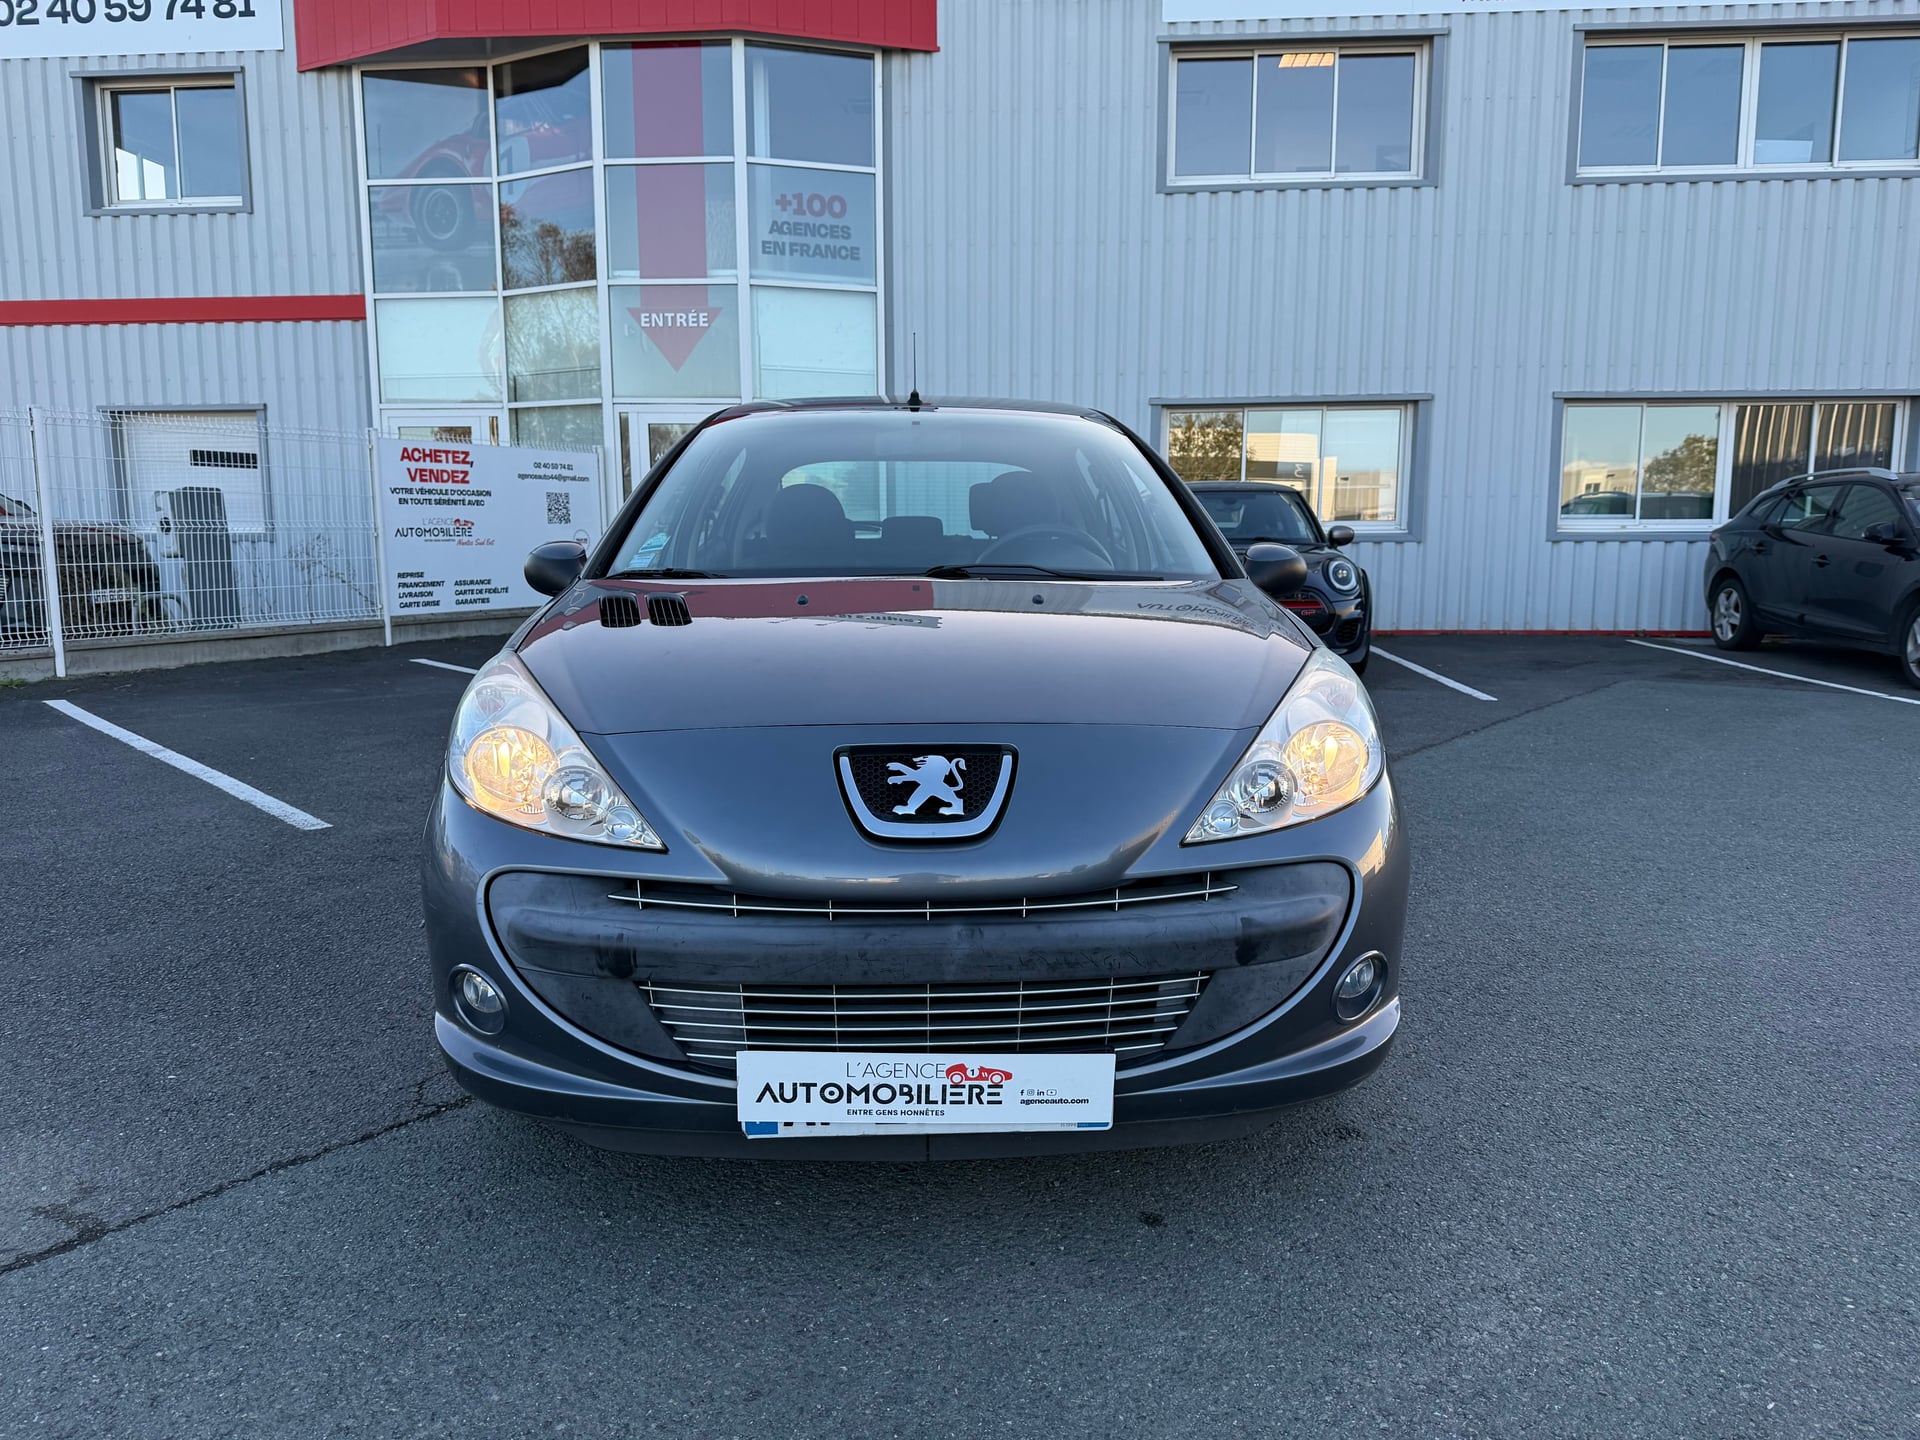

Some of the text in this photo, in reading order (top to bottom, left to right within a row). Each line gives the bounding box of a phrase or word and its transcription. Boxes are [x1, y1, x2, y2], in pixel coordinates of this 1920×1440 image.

[46, 0, 96, 24] 40
[103, 0, 152, 23] 59
[775, 192, 847, 219] +100
[768, 220, 852, 240] AGENCES
[761, 240, 861, 261] EN FRANCE
[640, 310, 709, 327] ENTRÉE
[400, 447, 474, 468] ACHETEZ,
[407, 468, 470, 484] VENDEZ
[390, 486, 492, 497] VOTRE VÉHICULE D'OCCASION
[434, 497, 466, 506] SÉRÉNITÉ
[422, 517, 455, 526] L'AGENCE
[397, 571, 424, 579] REPRISE
[398, 580, 445, 589] FINANCEMENT
[454, 578, 492, 586] ASSURANCE
[398, 590, 434, 599] LIVRAISON
[454, 588, 475, 596] CARTE
[484, 586, 509, 595] FIDÉLITÉ
[399, 599, 441, 609] CARTE GRISE
[455, 597, 490, 606] GARANTIES
[846, 1062, 946, 1079] L'AGENCE
[1020, 1097, 1090, 1106] agenceauto.com
[846, 1107, 946, 1118] ENTRE GENS HONNÊTES
